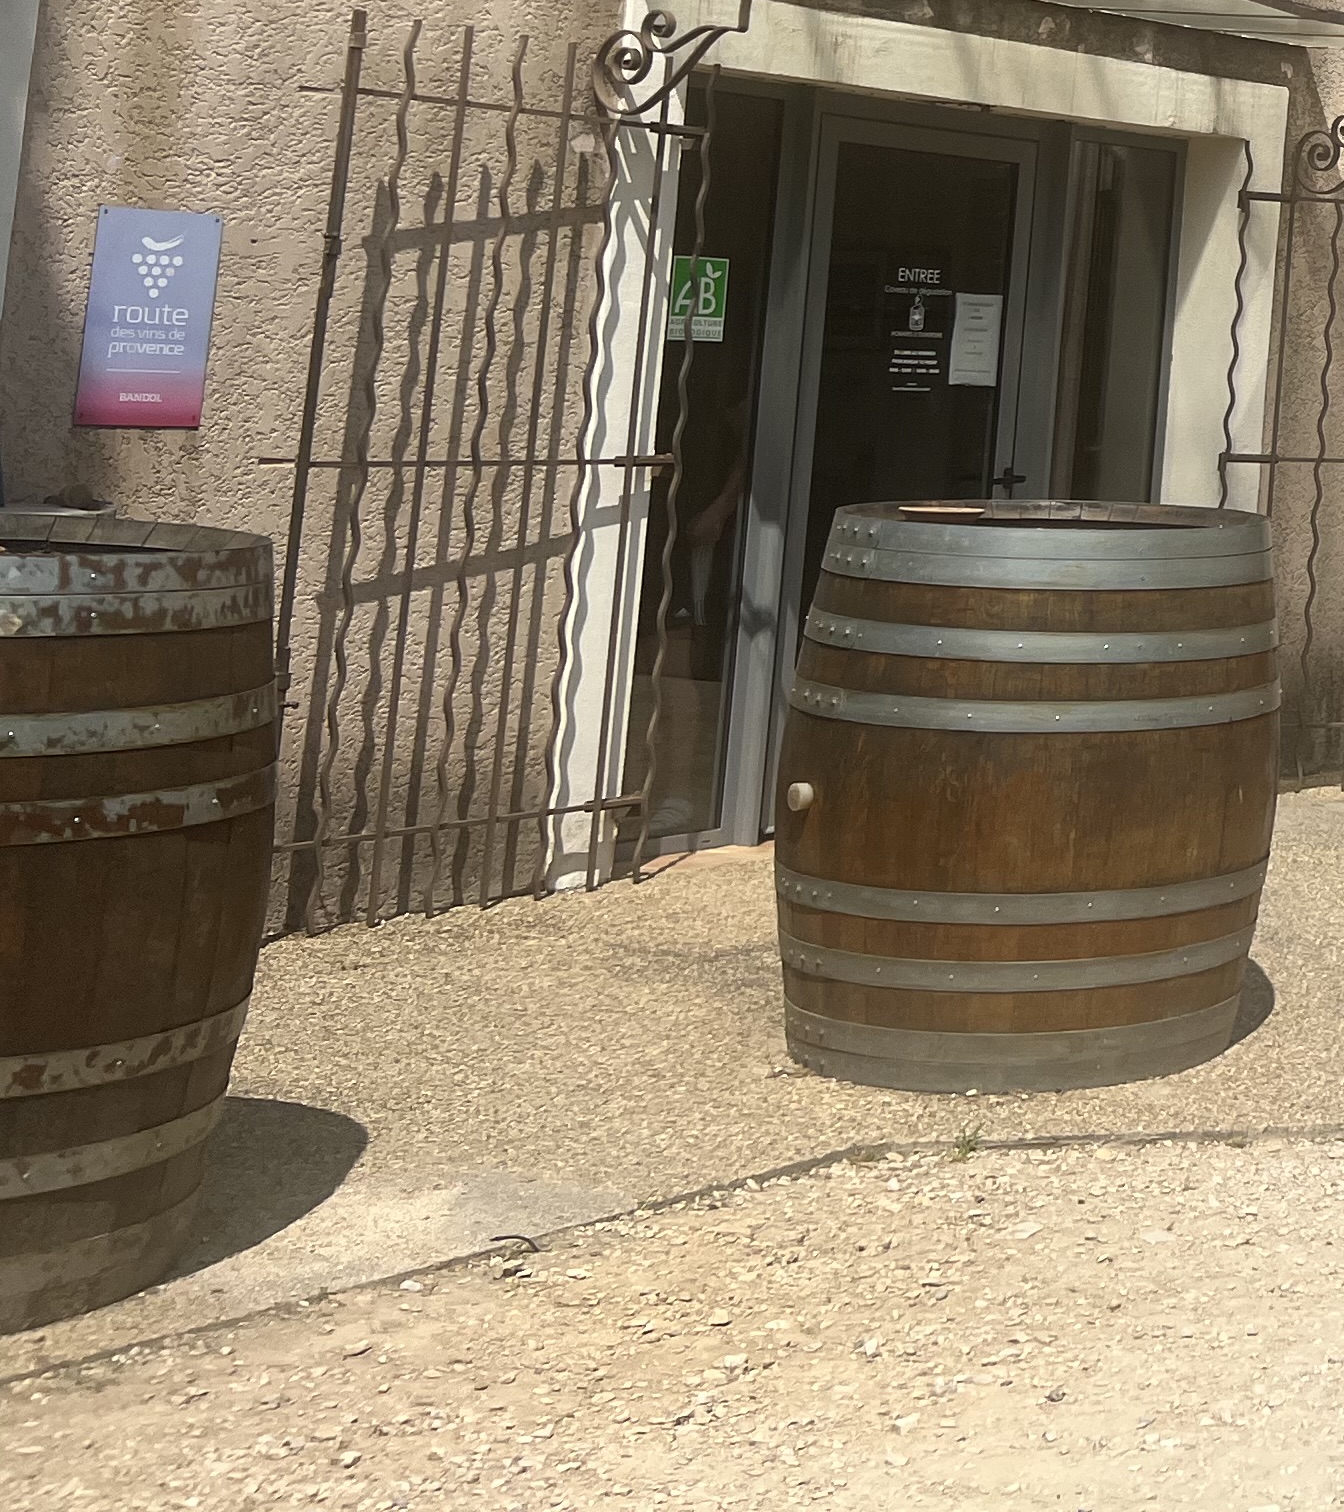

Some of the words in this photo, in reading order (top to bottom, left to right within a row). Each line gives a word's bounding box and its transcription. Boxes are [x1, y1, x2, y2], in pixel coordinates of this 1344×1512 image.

[898, 268, 941, 283] ENTREE
[674, 276, 716, 315] AB
[112, 304, 189, 326] route
[111, 326, 135, 338] des
[137, 327, 166, 340] vins
[168, 328, 185, 340] de
[107, 341, 185, 358] provence
[119, 393, 162, 402] BANDOL
